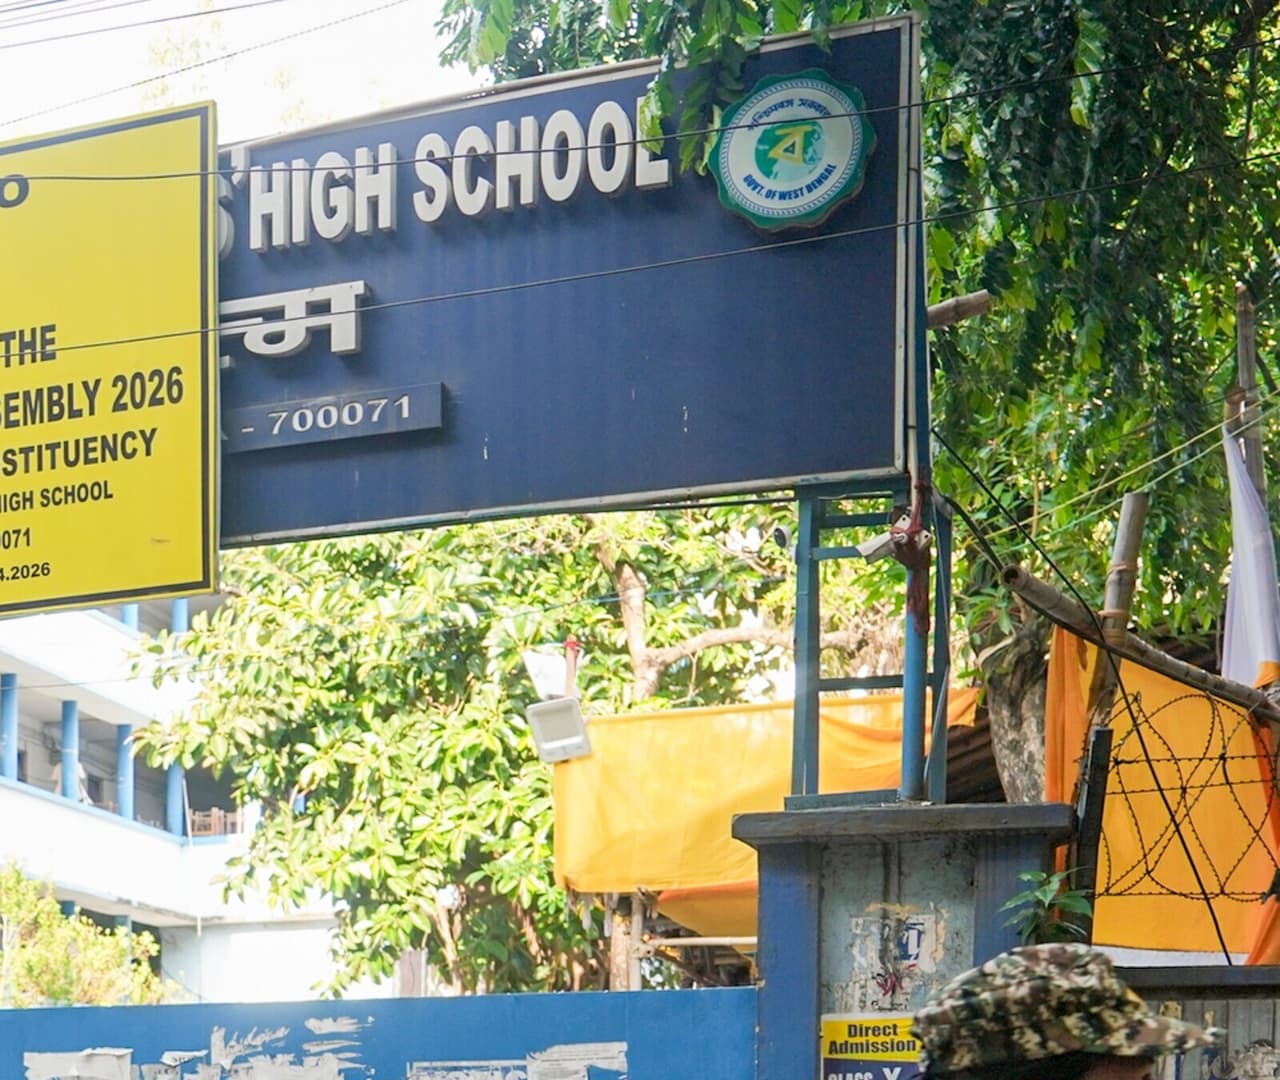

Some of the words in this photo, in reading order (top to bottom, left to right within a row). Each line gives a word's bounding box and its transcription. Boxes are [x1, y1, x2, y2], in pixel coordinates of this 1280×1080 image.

[249, 143, 397, 254] HIGH
[412, 97, 672, 224] SCHOOL
[743, 174, 765, 195] GOVT.
[765, 189, 779, 200] OF
[778, 188, 805, 200] WEST
[807, 164, 837, 189] BENGAL
[0, 324, 57, 366] THE
[111, 366, 184, 412] 2026
[267, 394, 409, 434] 700071
[39, 479, 113, 510] SCHOOL
[828, 1041, 916, 1055] Admission
[848, 1024, 898, 1037] Direct
